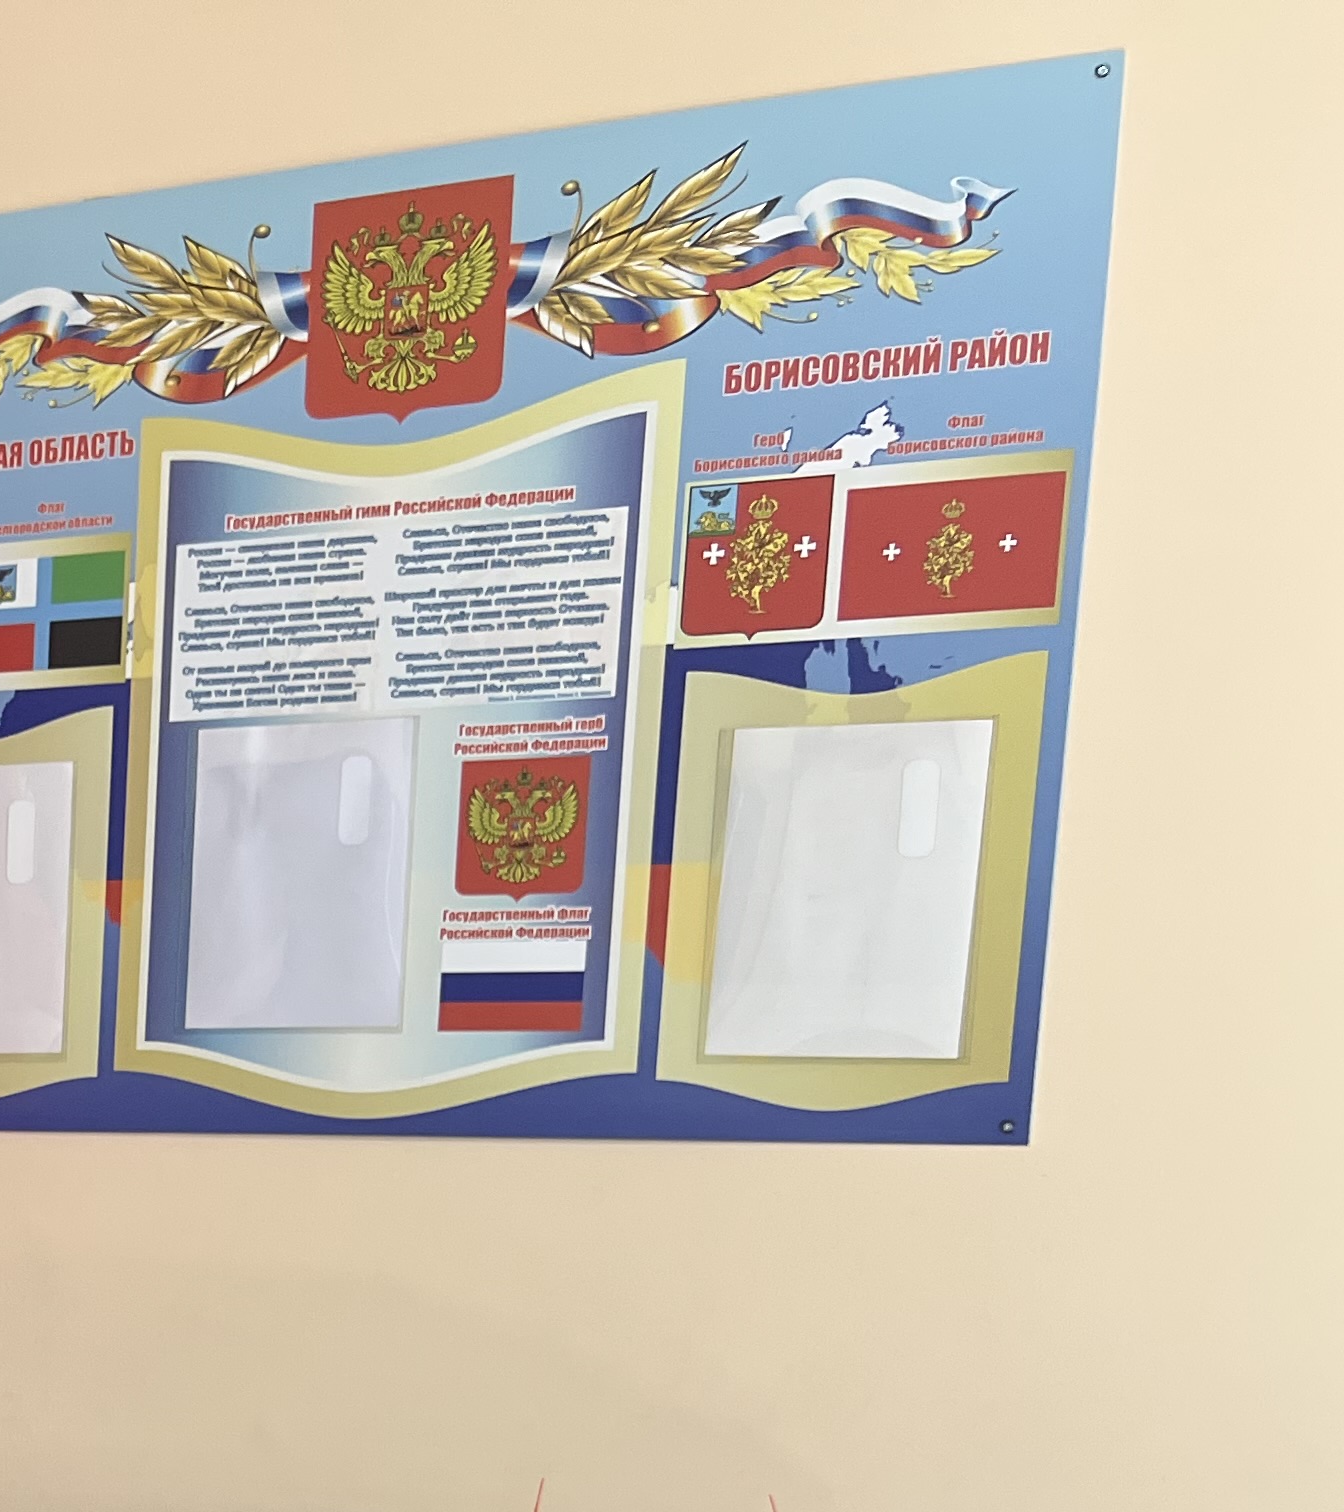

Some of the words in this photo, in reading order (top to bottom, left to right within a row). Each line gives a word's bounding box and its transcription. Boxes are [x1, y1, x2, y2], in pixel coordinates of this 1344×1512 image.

[723, 336, 941, 395] БОРИСОВСКИЙ
[949, 329, 1051, 372] РАЙОН
[28, 430, 135, 466] ОБЛАСТЬ
[887, 437, 987, 455] Борисовского
[990, 429, 1044, 447] района
[694, 452, 789, 473] Борисовского
[792, 447, 843, 465] района
[226, 503, 352, 531] Государственный
[355, 502, 391, 519] гимн
[393, 494, 482, 516] Российской
[484, 486, 575, 507] Федерации
[459, 718, 573, 738] Государственный
[454, 739, 528, 755] Российской
[531, 737, 606, 753] Федерации
[442, 907, 555, 923] Государственный
[440, 926, 513, 940] Российской
[515, 925, 590, 939] Федерации
